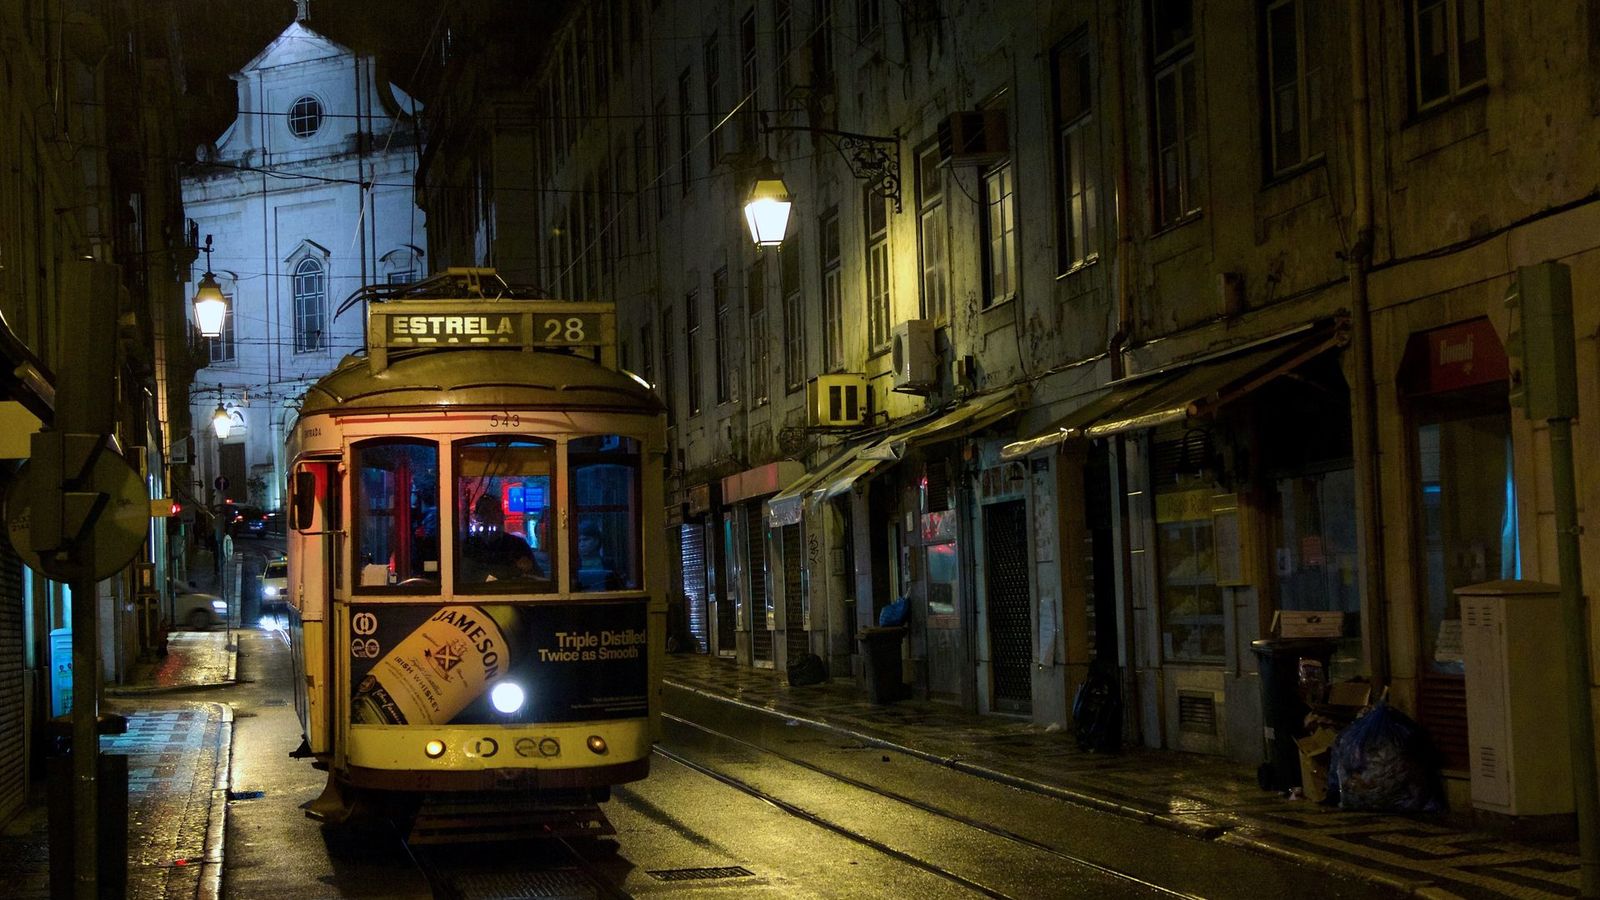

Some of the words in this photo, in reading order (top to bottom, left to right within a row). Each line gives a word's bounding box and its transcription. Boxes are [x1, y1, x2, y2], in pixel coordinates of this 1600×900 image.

[393, 316, 514, 335] ESTRELA
[544, 317, 586, 344] 28
[490, 414, 520, 428] 543
[431, 607, 499, 681] JAMESON
[555, 630, 599, 651] Triple
[600, 628, 647, 646] Distilled
[538, 648, 580, 663] Twice
[581, 650, 598, 662] as
[598, 645, 640, 661] Smooth
[394, 655, 415, 675] IRISH
[413, 673, 440, 713] WHISKEY
